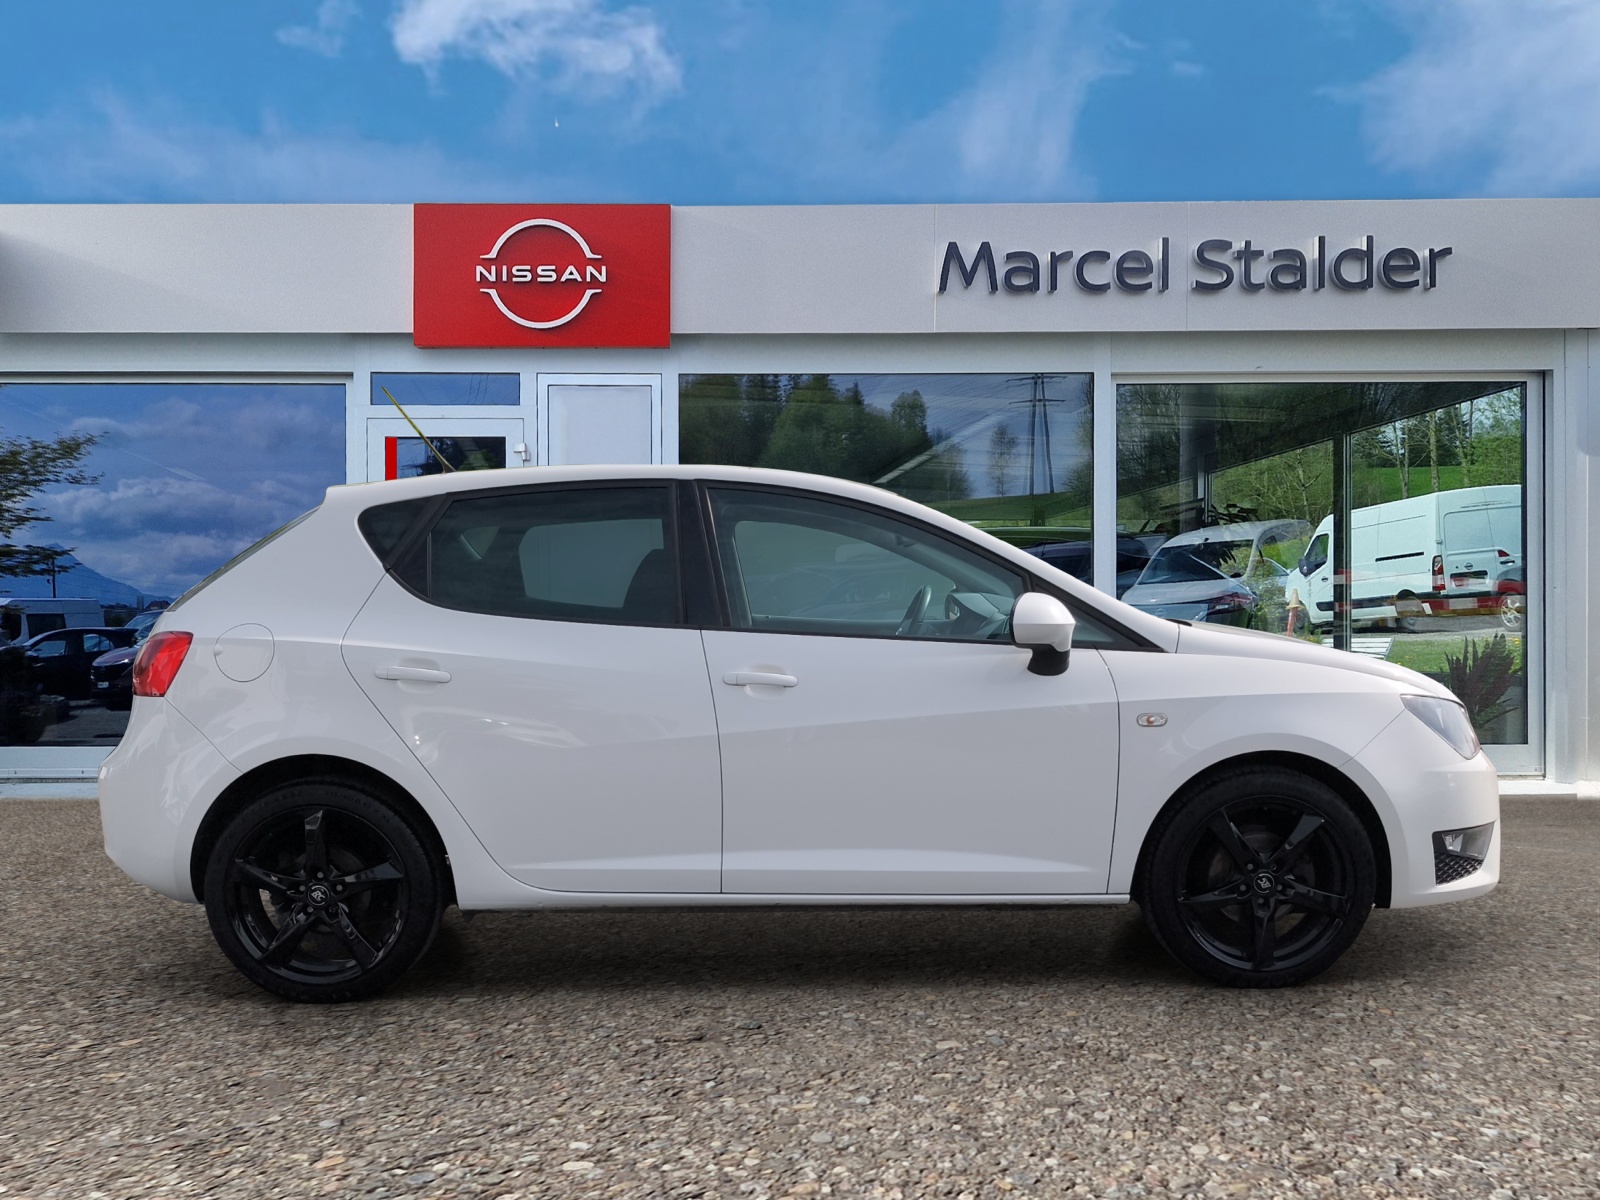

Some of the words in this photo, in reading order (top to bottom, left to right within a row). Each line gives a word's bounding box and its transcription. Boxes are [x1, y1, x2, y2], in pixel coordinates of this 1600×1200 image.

[475, 265, 607, 283] NISSAN
[937, 237, 1170, 297] Marcel
[1191, 235, 1453, 297] Stalder
